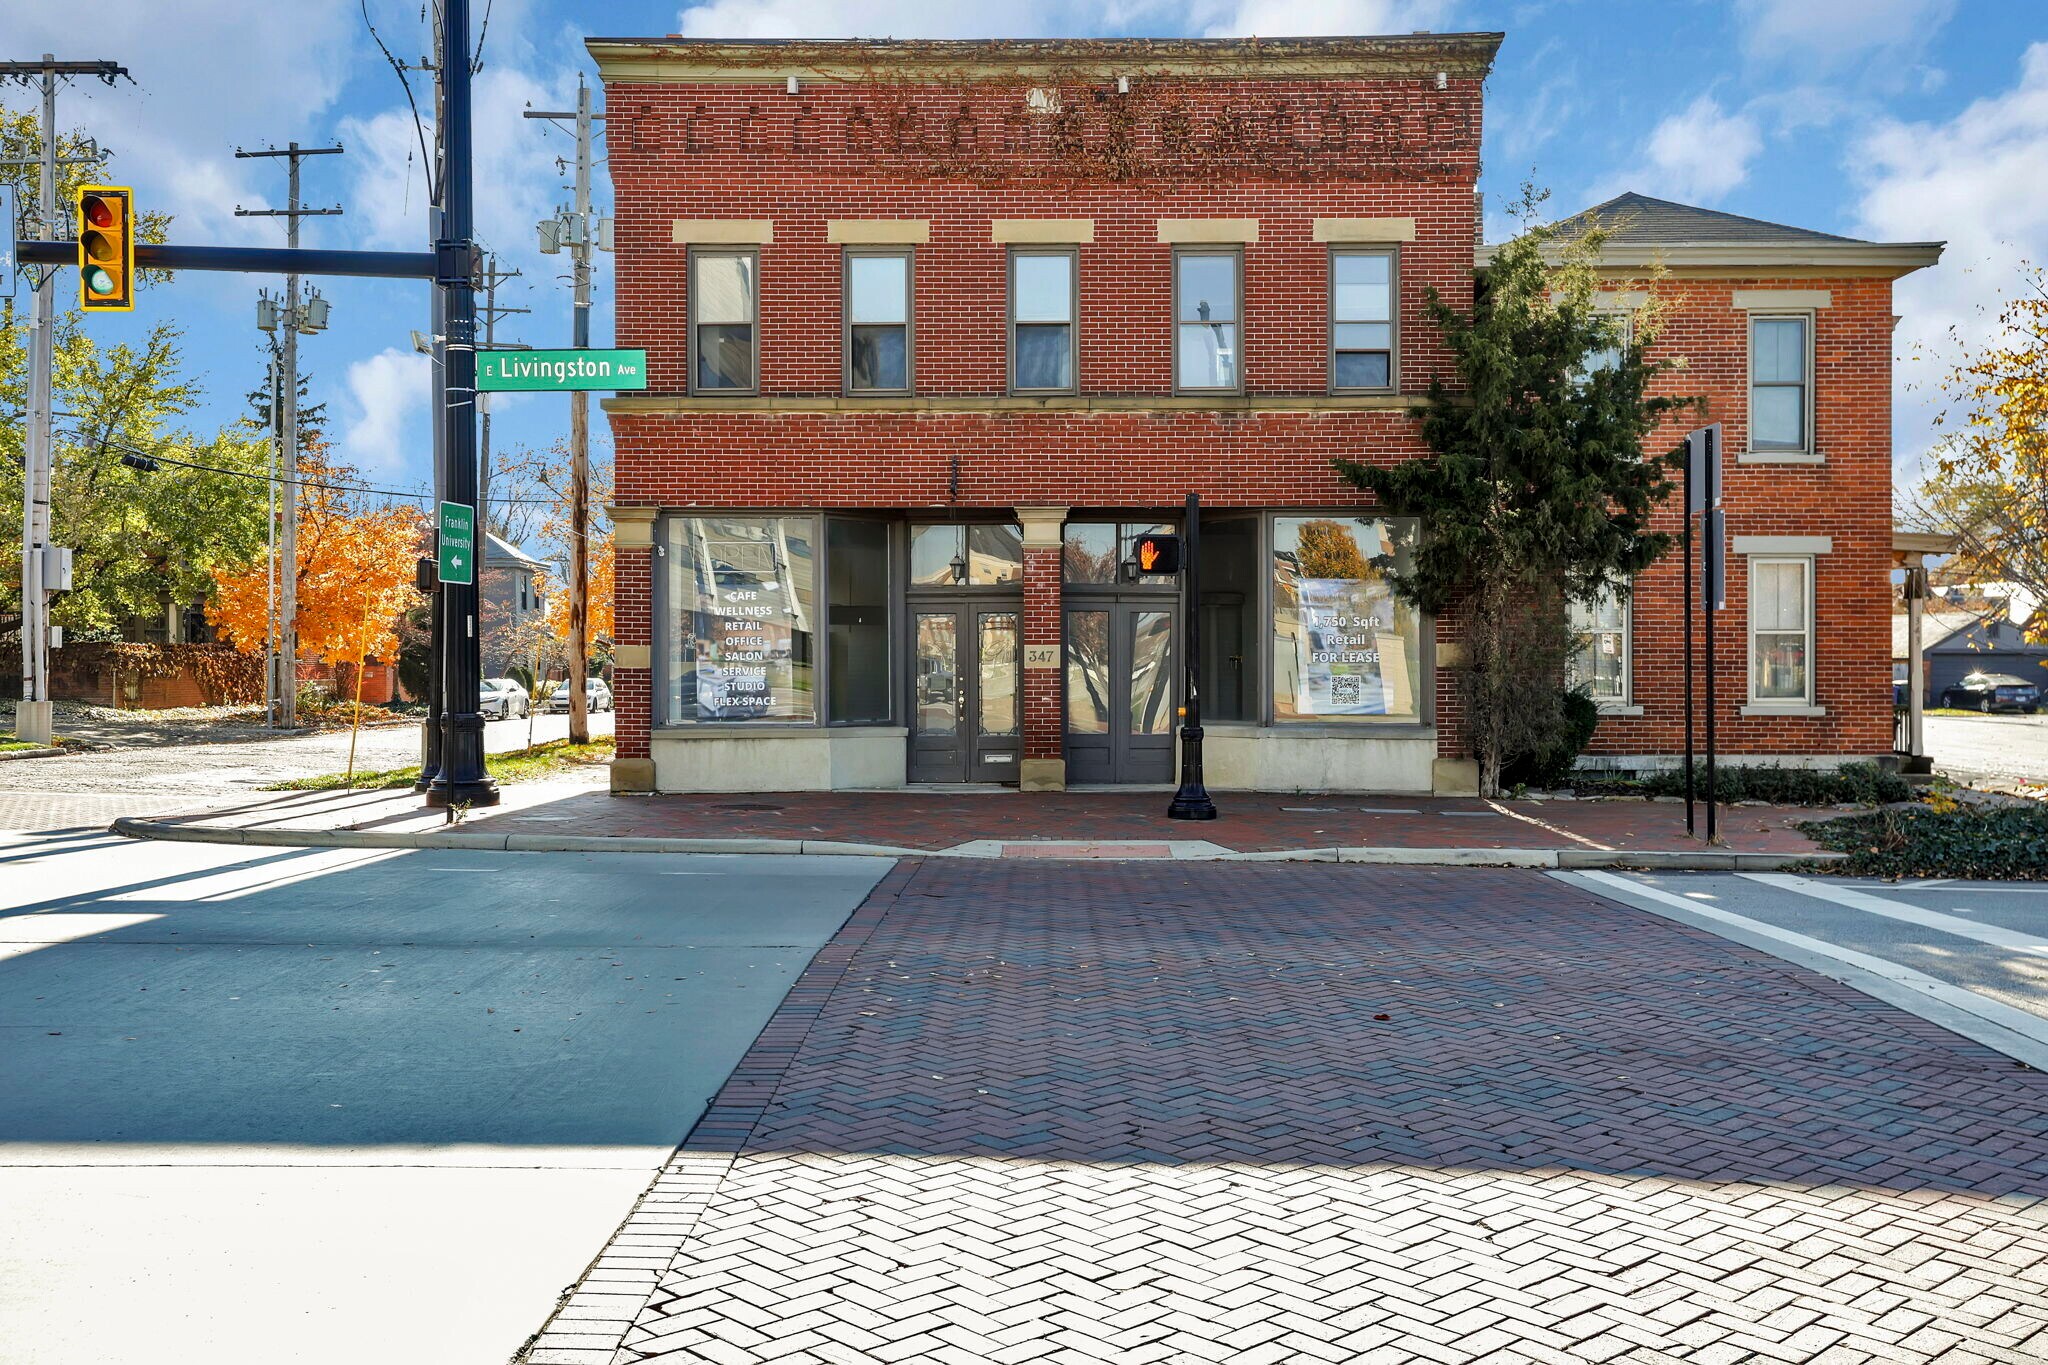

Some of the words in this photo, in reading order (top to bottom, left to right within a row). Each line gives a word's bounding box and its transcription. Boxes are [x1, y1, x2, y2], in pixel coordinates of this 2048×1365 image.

[486, 365, 493, 376] E
[500, 357, 611, 383] Livingston
[617, 364, 636, 375] Ave
[445, 515, 469, 531] Franklin
[441, 533, 471, 551] University
[730, 591, 757, 601] CAFE
[714, 606, 773, 616] WELLNESS
[725, 621, 763, 631] RETAIL
[1352, 616, 1380, 630] Sqft
[725, 636, 763, 646] OFFICE
[1327, 634, 1365, 645] Retail
[725, 651, 763, 661] SALON
[1028, 650, 1054, 663] 347
[1312, 652, 1339, 663] FOR
[1341, 652, 1380, 663] LEASE
[722, 666, 767, 676] SERVICE
[724, 681, 765, 691] STUDIO
[713, 696, 740, 706] FLEX
[742, 696, 777, 706] SPACE
